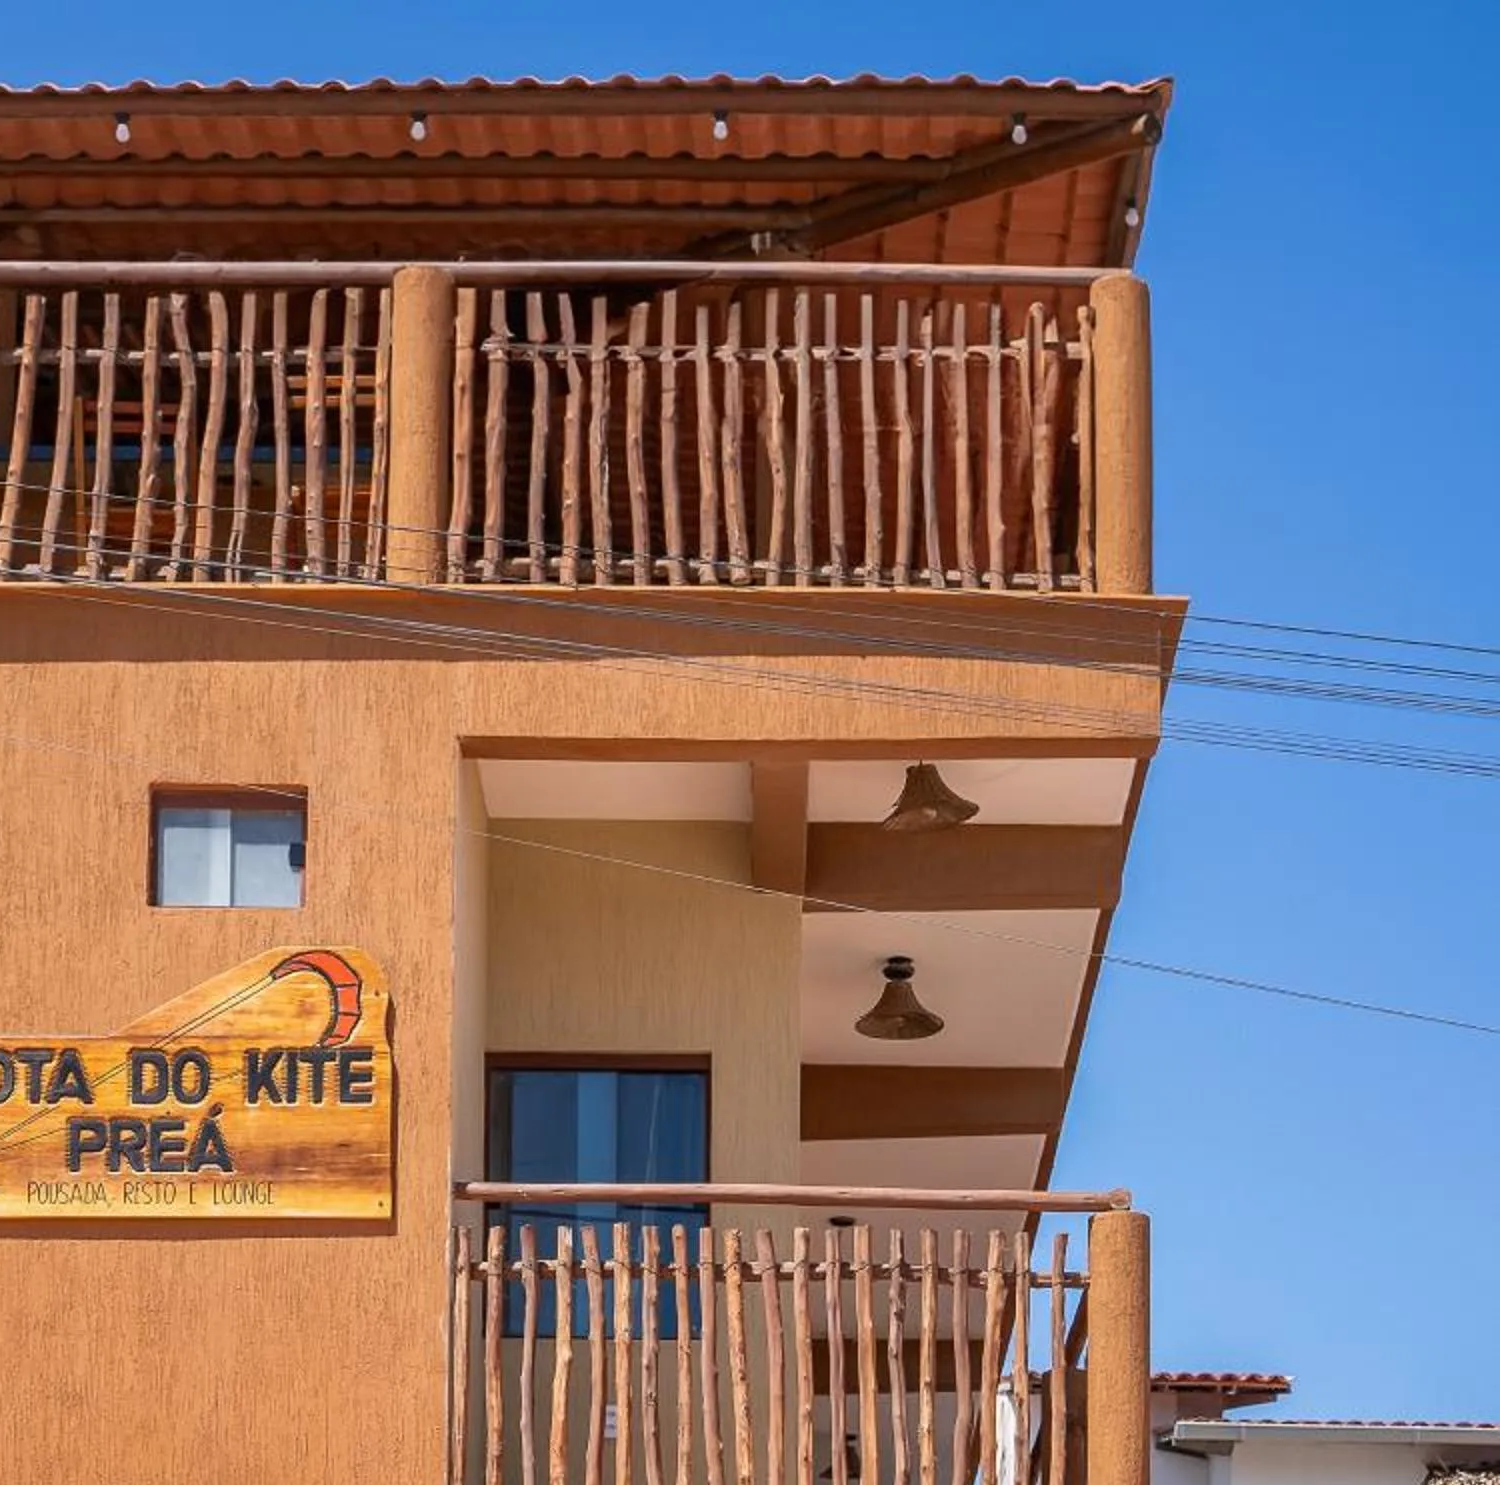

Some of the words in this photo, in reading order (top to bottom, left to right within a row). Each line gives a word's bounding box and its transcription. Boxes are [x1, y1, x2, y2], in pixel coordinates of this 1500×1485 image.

[127, 1047, 211, 1105] DO
[243, 1047, 375, 1105] KITE
[66, 1103, 234, 1173] PREÁ
[27, 1181, 112, 1207] POUSADA,
[123, 1181, 176, 1205] RESTO
[188, 1180, 197, 1205] E
[213, 1180, 275, 1205] LOUNGE
